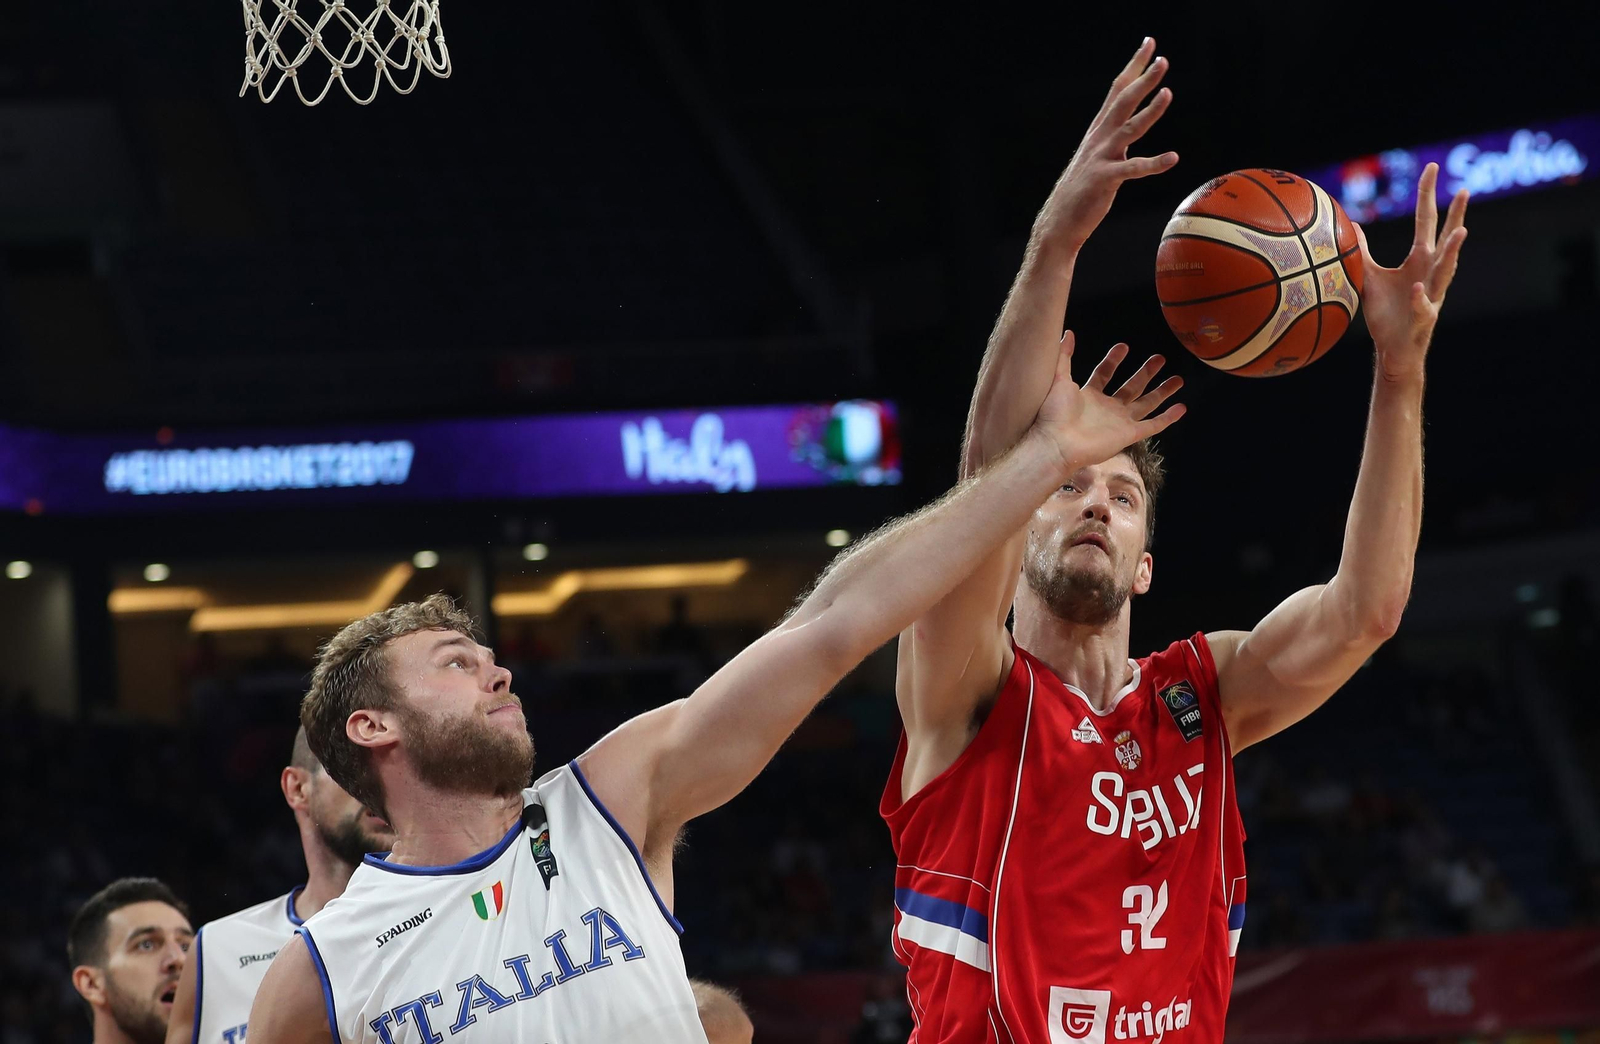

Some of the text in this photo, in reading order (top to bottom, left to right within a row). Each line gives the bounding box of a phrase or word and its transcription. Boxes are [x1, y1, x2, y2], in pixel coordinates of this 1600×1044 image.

[1446, 128, 1588, 197] Serbia
[103, 440, 414, 495] #EUROBASKET2017
[620, 413, 757, 493] Italy
[375, 907, 433, 949] SPALDING
[1121, 879, 1169, 955] 32
[369, 907, 646, 1044] ITALIA
